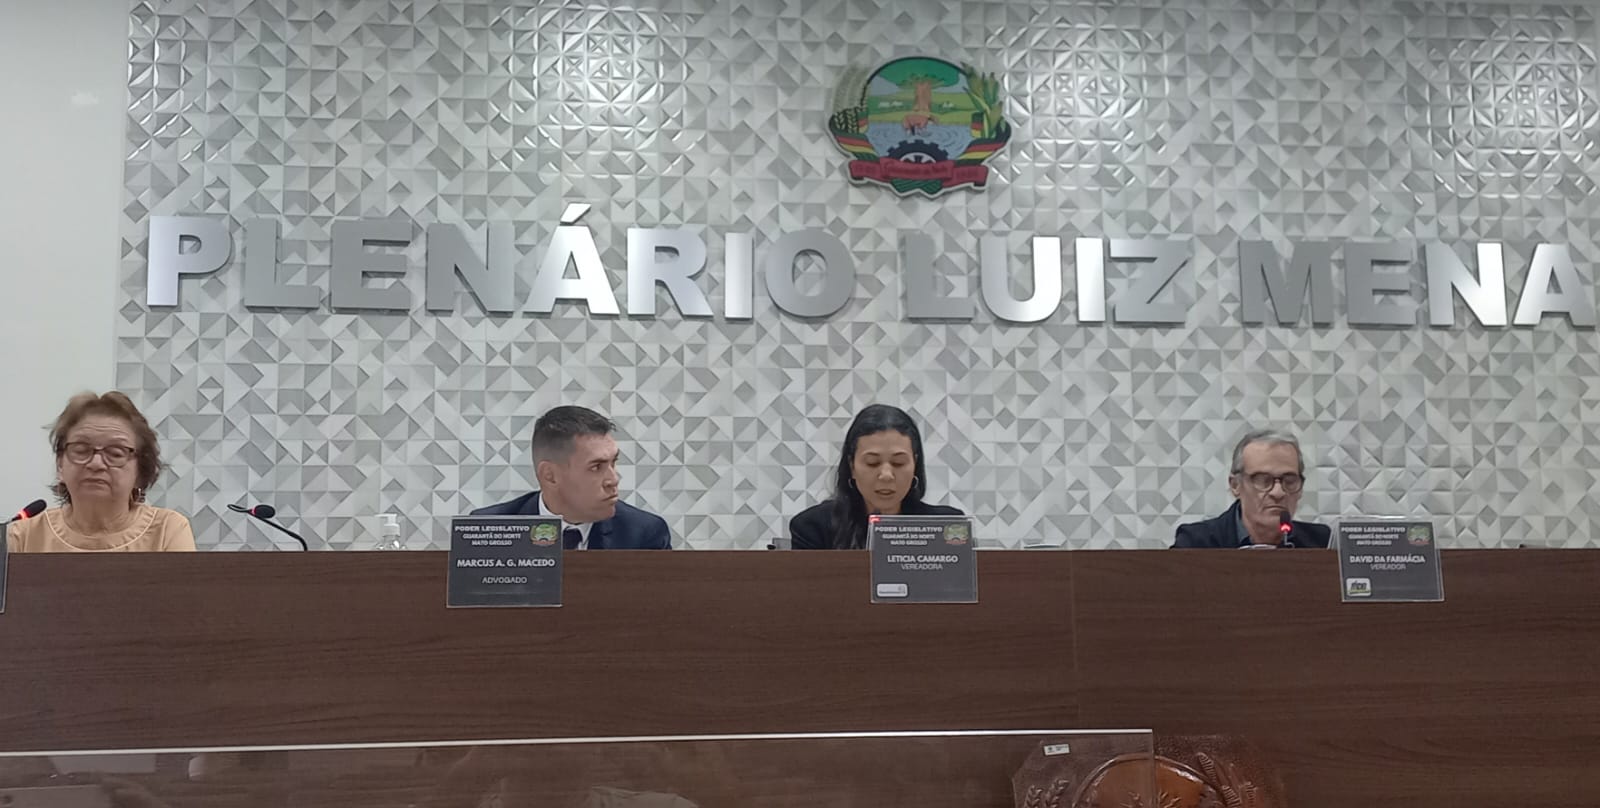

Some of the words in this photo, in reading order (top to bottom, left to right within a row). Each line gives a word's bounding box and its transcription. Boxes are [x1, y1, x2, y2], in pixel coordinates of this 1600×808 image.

[147, 203, 857, 319] PLENÁRIO
[904, 234, 1191, 324] LUIZ
[1239, 239, 1597, 327] MENA
[887, 555, 916, 563] LETICIA
[917, 555, 959, 563] CAMARGO
[1349, 555, 1374, 563] DAVID
[1374, 555, 1386, 563] DA
[1386, 553, 1426, 563] FARMÁCIA
[456, 559, 494, 567] MARCUS
[495, 559, 505, 567] A.
[506, 559, 517, 567] G.
[518, 559, 556, 567] MACEDO
[482, 576, 528, 584] ADVOGADO
